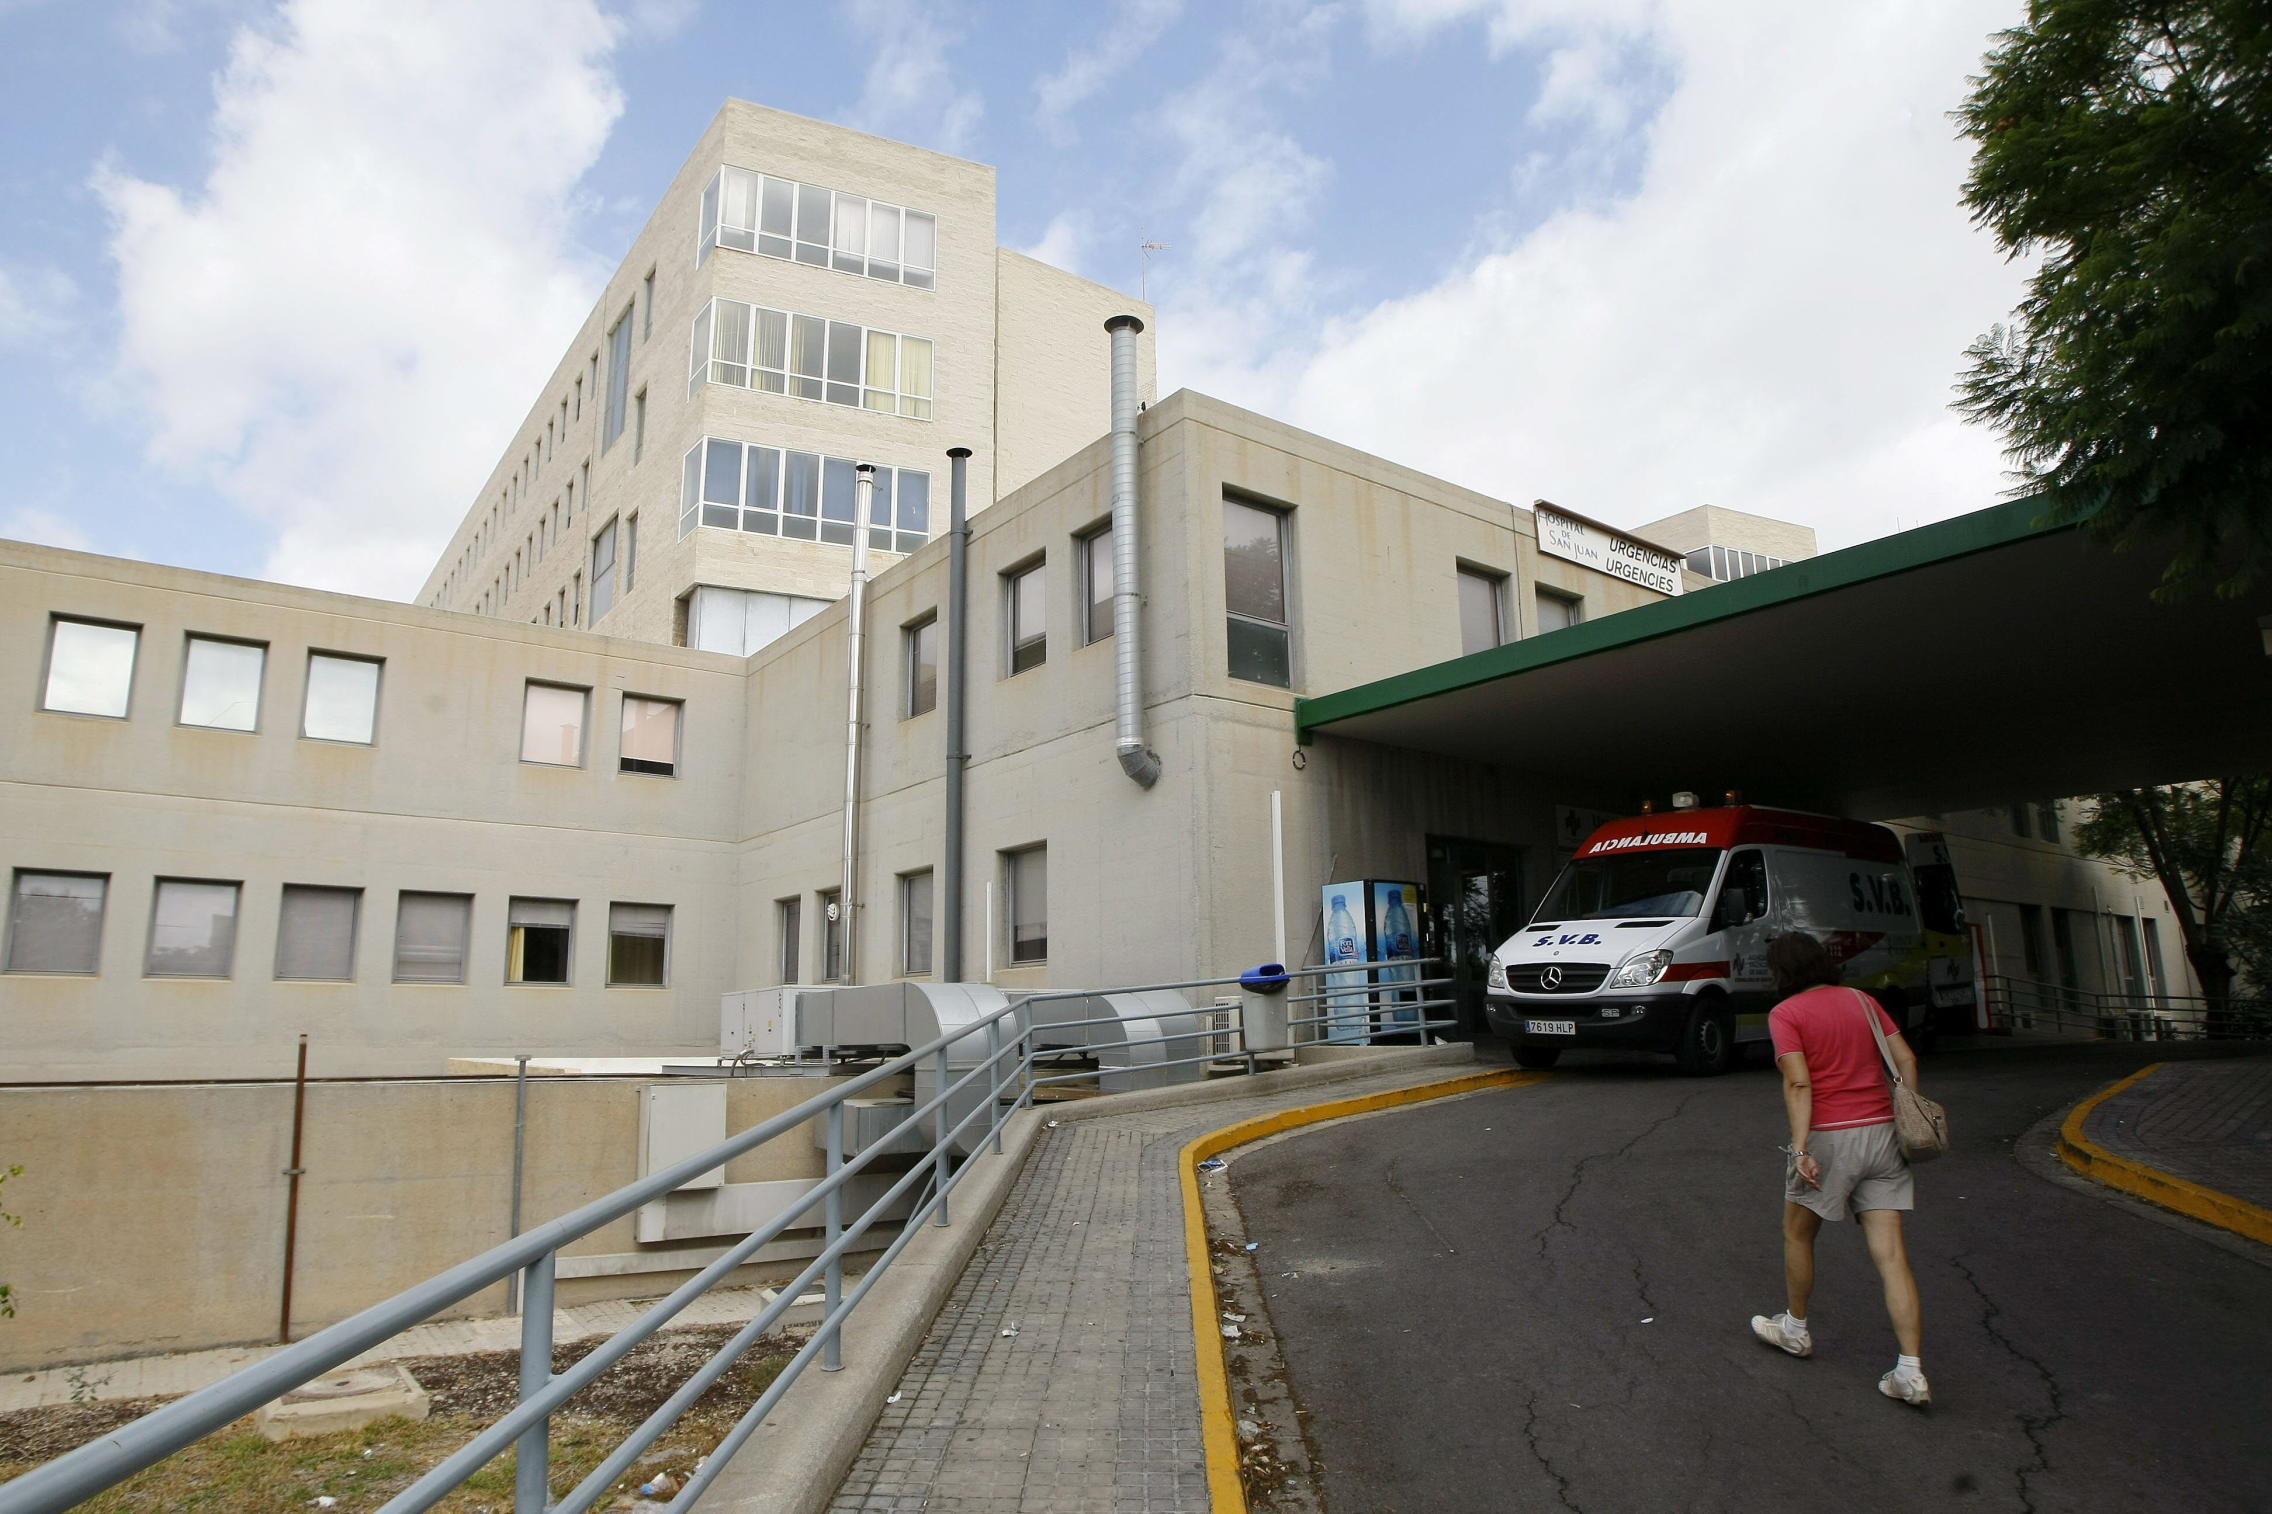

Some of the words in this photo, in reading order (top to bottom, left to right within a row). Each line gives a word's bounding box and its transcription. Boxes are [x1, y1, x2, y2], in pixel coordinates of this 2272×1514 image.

[1537, 509, 1585, 536] HOSPITAL
[1561, 529, 1571, 540] DE
[1549, 529, 1571, 550] SAN
[1574, 542, 1599, 560] JUAN
[1609, 537, 1677, 574] URGENCIAS
[1605, 557, 1674, 593] URGENCIES
[1849, 872, 1911, 917] S.V.B.
[1532, 933, 1602, 947] S.V.B.
[1531, 1022, 1554, 1033] 7619
[1556, 1023, 1574, 1033] HLP
